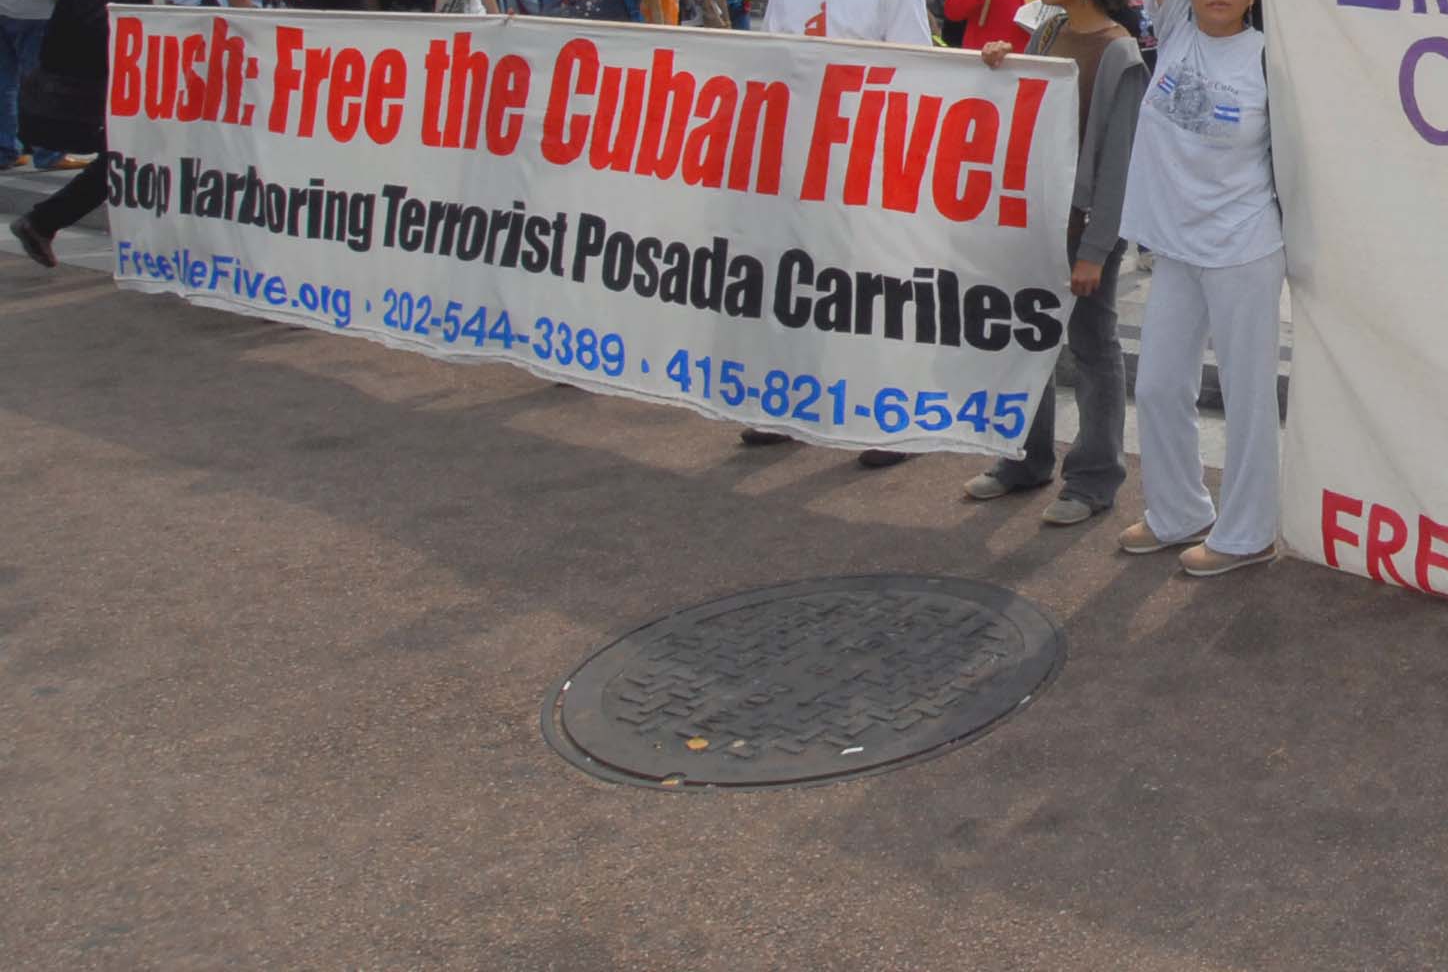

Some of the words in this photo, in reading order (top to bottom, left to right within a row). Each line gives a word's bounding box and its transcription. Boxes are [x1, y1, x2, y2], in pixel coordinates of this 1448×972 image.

[110, 16, 260, 127] Bush:
[268, 25, 408, 146] Free
[420, 31, 532, 157] the
[540, 37, 792, 196] Cuban
[799, 62, 1050, 229] Five!
[105, 150, 171, 219] Stop
[179, 156, 377, 254] Harboring
[381, 183, 568, 278] Terrorist
[571, 212, 766, 320] Posada
[772, 247, 1065, 354] Carriles
[382, 287, 627, 379] 202-544-3389
[665, 348, 1030, 440] 415-821-6545
